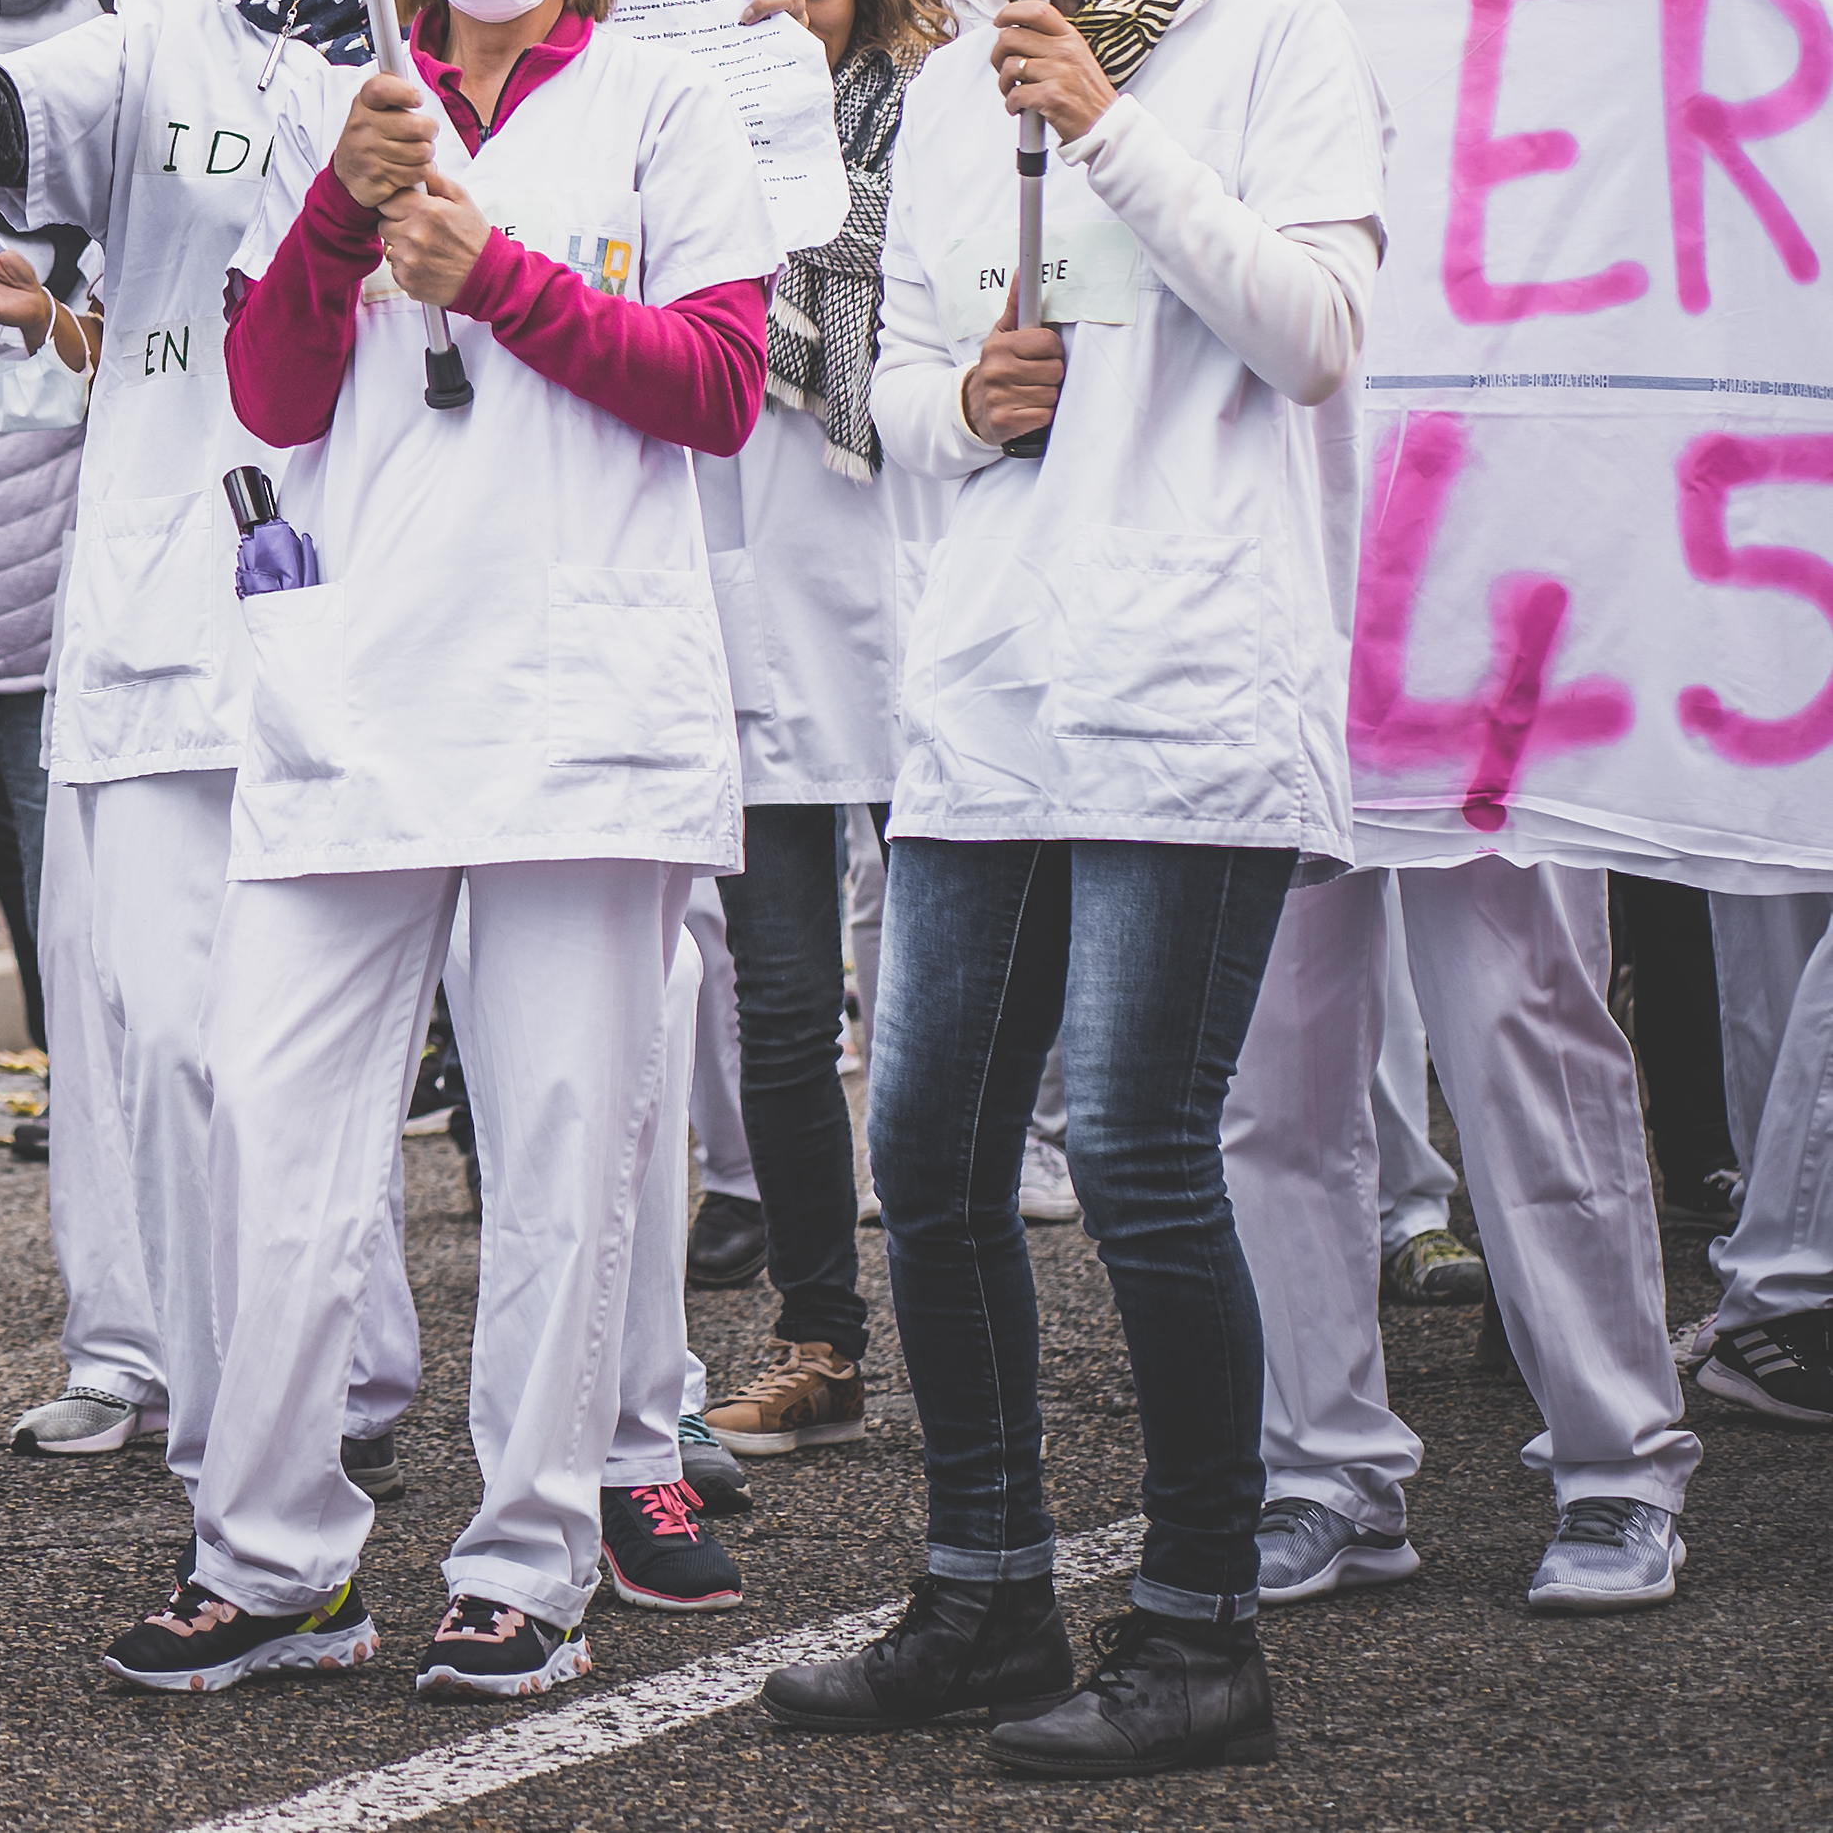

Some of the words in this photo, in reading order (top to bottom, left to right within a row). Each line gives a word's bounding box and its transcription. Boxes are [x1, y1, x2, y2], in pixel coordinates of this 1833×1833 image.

[980, 267, 1006, 291] EN
[145, 325, 189, 377] EN
[1349, 411, 1833, 836] 45
